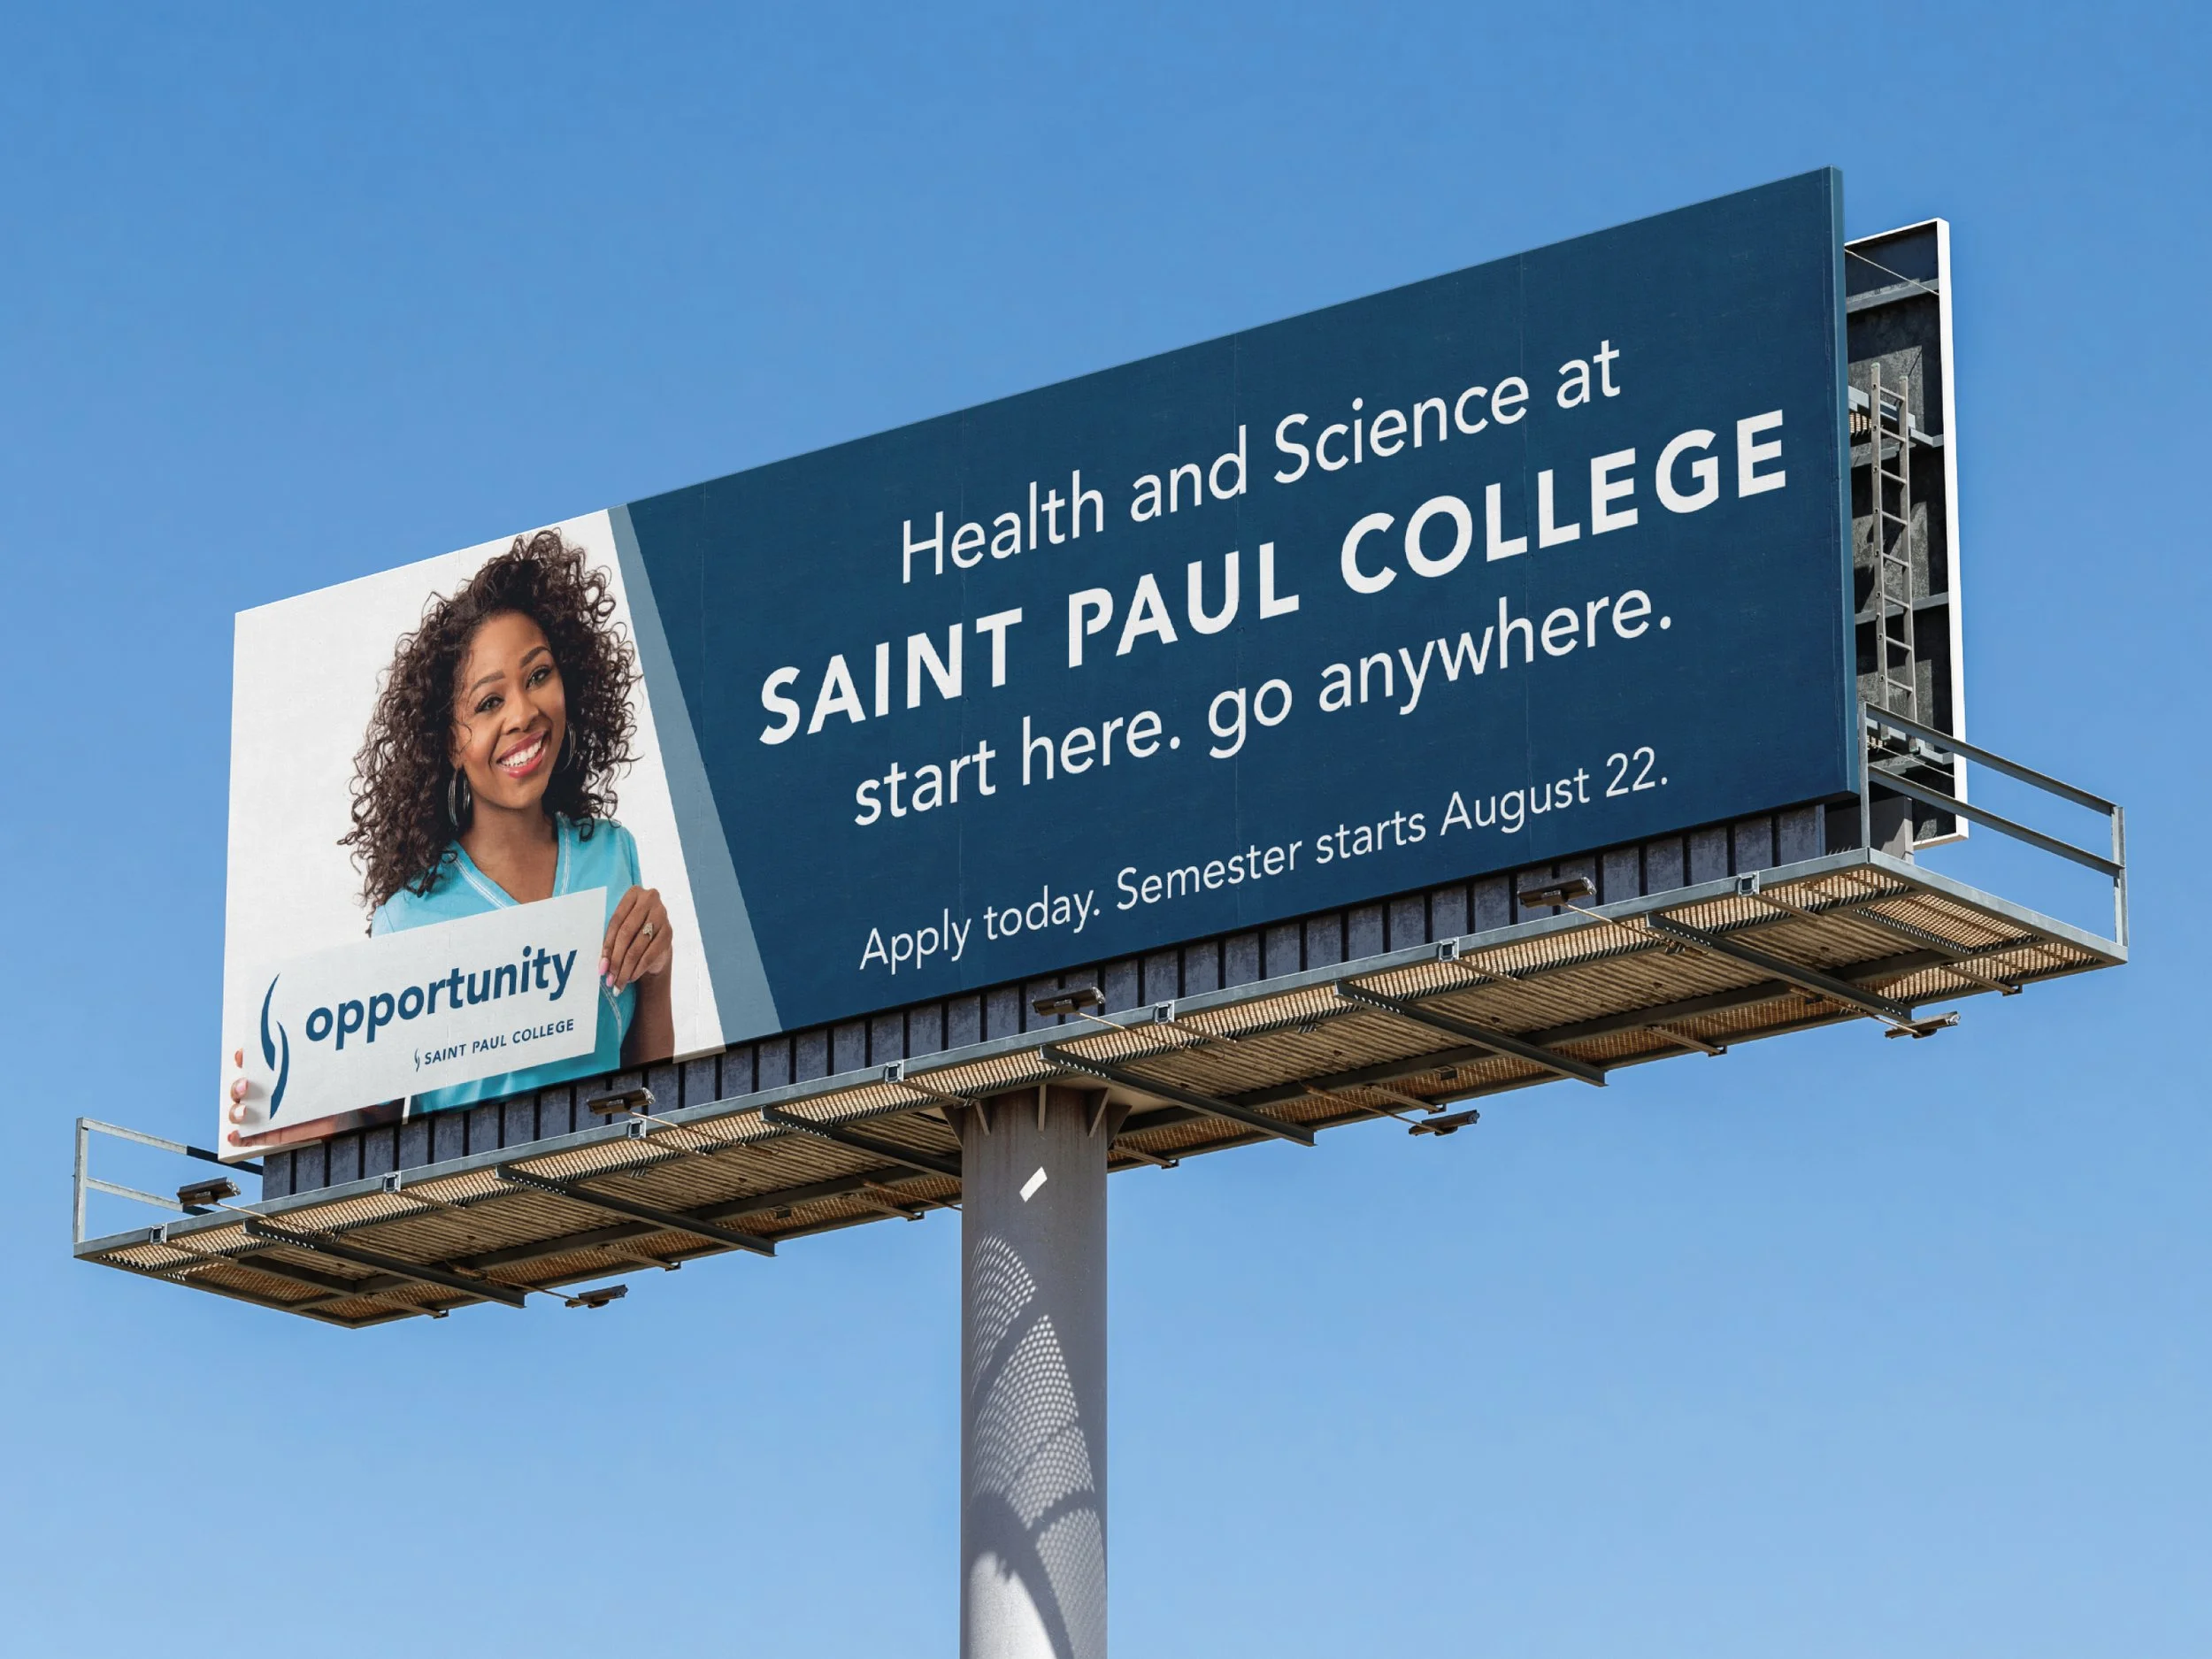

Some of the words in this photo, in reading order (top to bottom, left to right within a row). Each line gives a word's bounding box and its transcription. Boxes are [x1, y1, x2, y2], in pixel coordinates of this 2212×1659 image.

[759, 607, 1023, 745] SAINT
[1068, 541, 1300, 668] PAUL
[1340, 409, 1786, 594] COLLEGE
[902, 469, 1103, 584] Health
[1130, 424, 1247, 522] and
[1273, 376, 1529, 484] Science
[1556, 340, 1620, 409] at
[855, 740, 996, 826] start
[1023, 710, 1180, 786] here.
[1208, 679, 1293, 759] go
[1319, 589, 1671, 715] anywhere.
[859, 908, 972, 975] Apply
[983, 885, 1101, 940] today.
[1117, 841, 1302, 910] Semester
[1316, 810, 1426, 864] starts
[1440, 768, 1590, 836] August
[1606, 747, 1668, 798] 22.
[305, 946, 577, 1051] opportunity
[424, 1044, 466, 1065] SAINT
[472, 1035, 507, 1054] PAUL
[512, 1019, 574, 1044] COLLEGE
